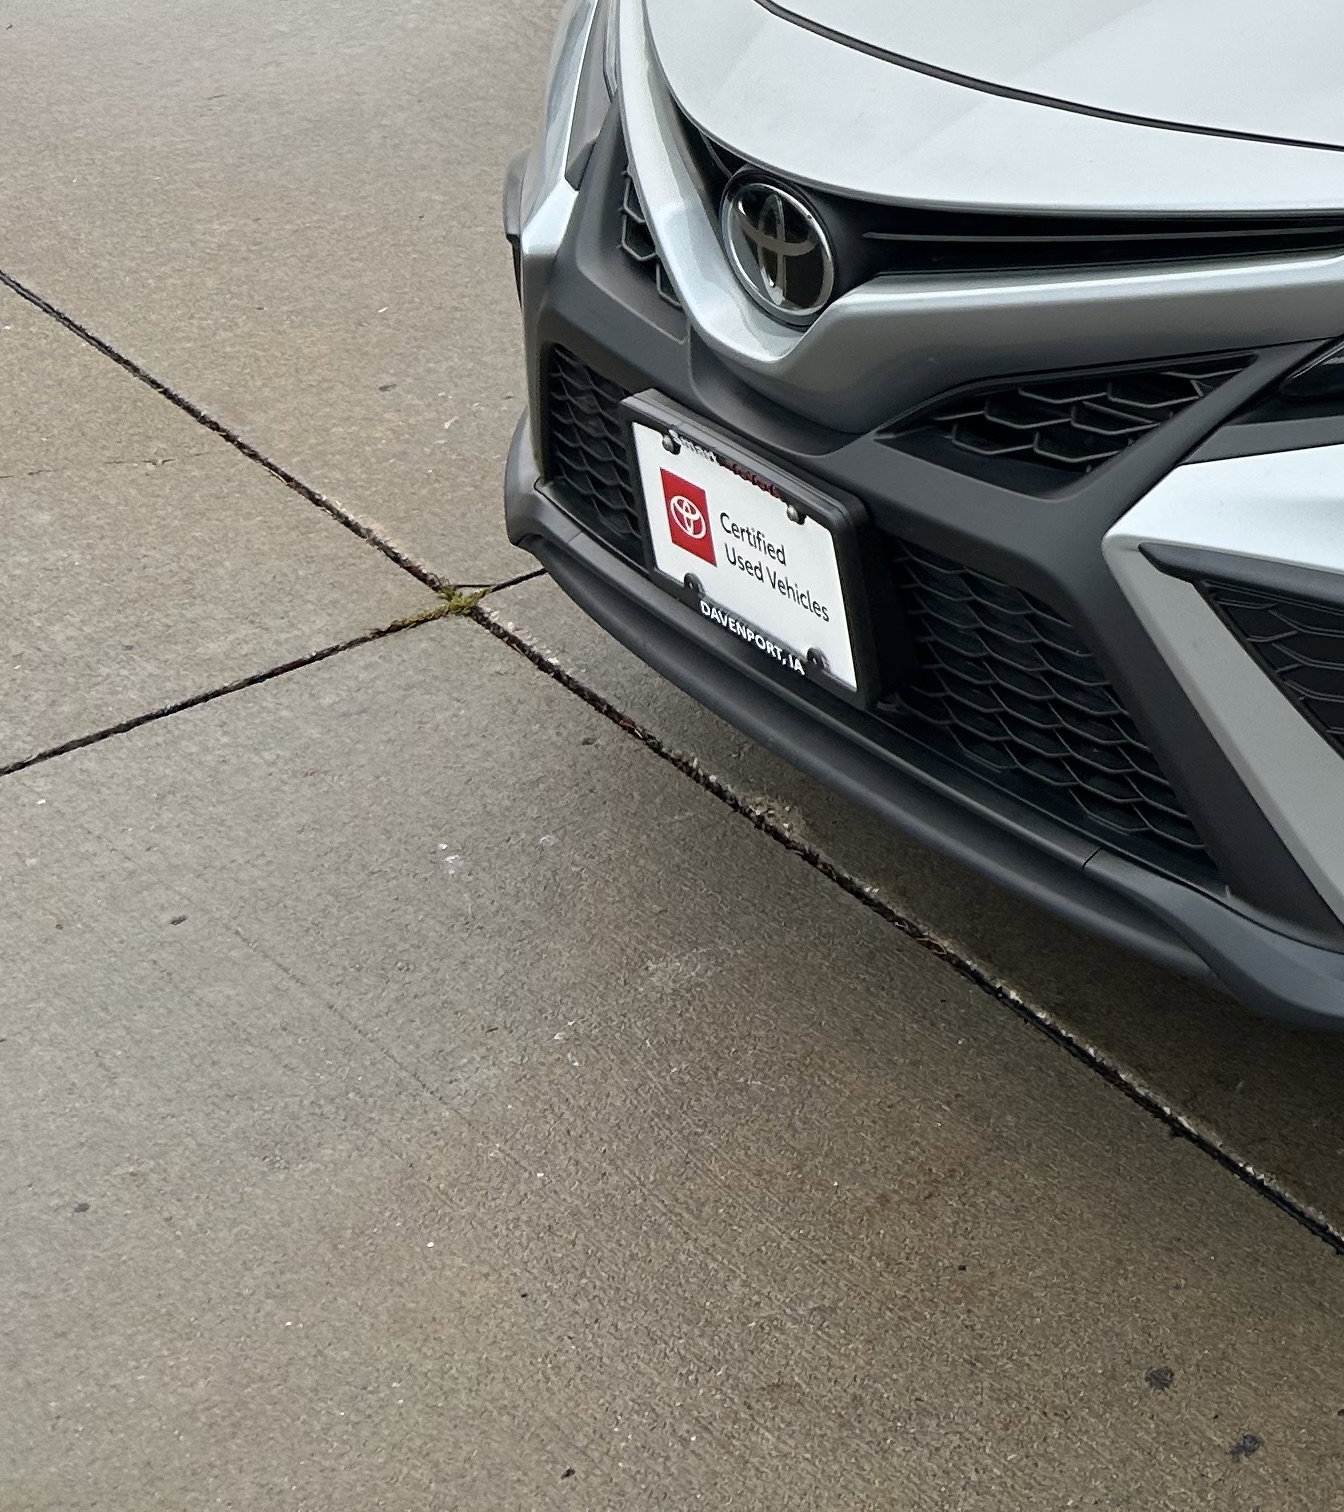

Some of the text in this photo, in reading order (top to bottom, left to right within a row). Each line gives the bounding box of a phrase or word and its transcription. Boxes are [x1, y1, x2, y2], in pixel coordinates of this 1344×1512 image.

[720, 512, 786, 566] Certified
[724, 542, 830, 622] Used Vehicles
[700, 600, 806, 676] DAVENPORT, IA
